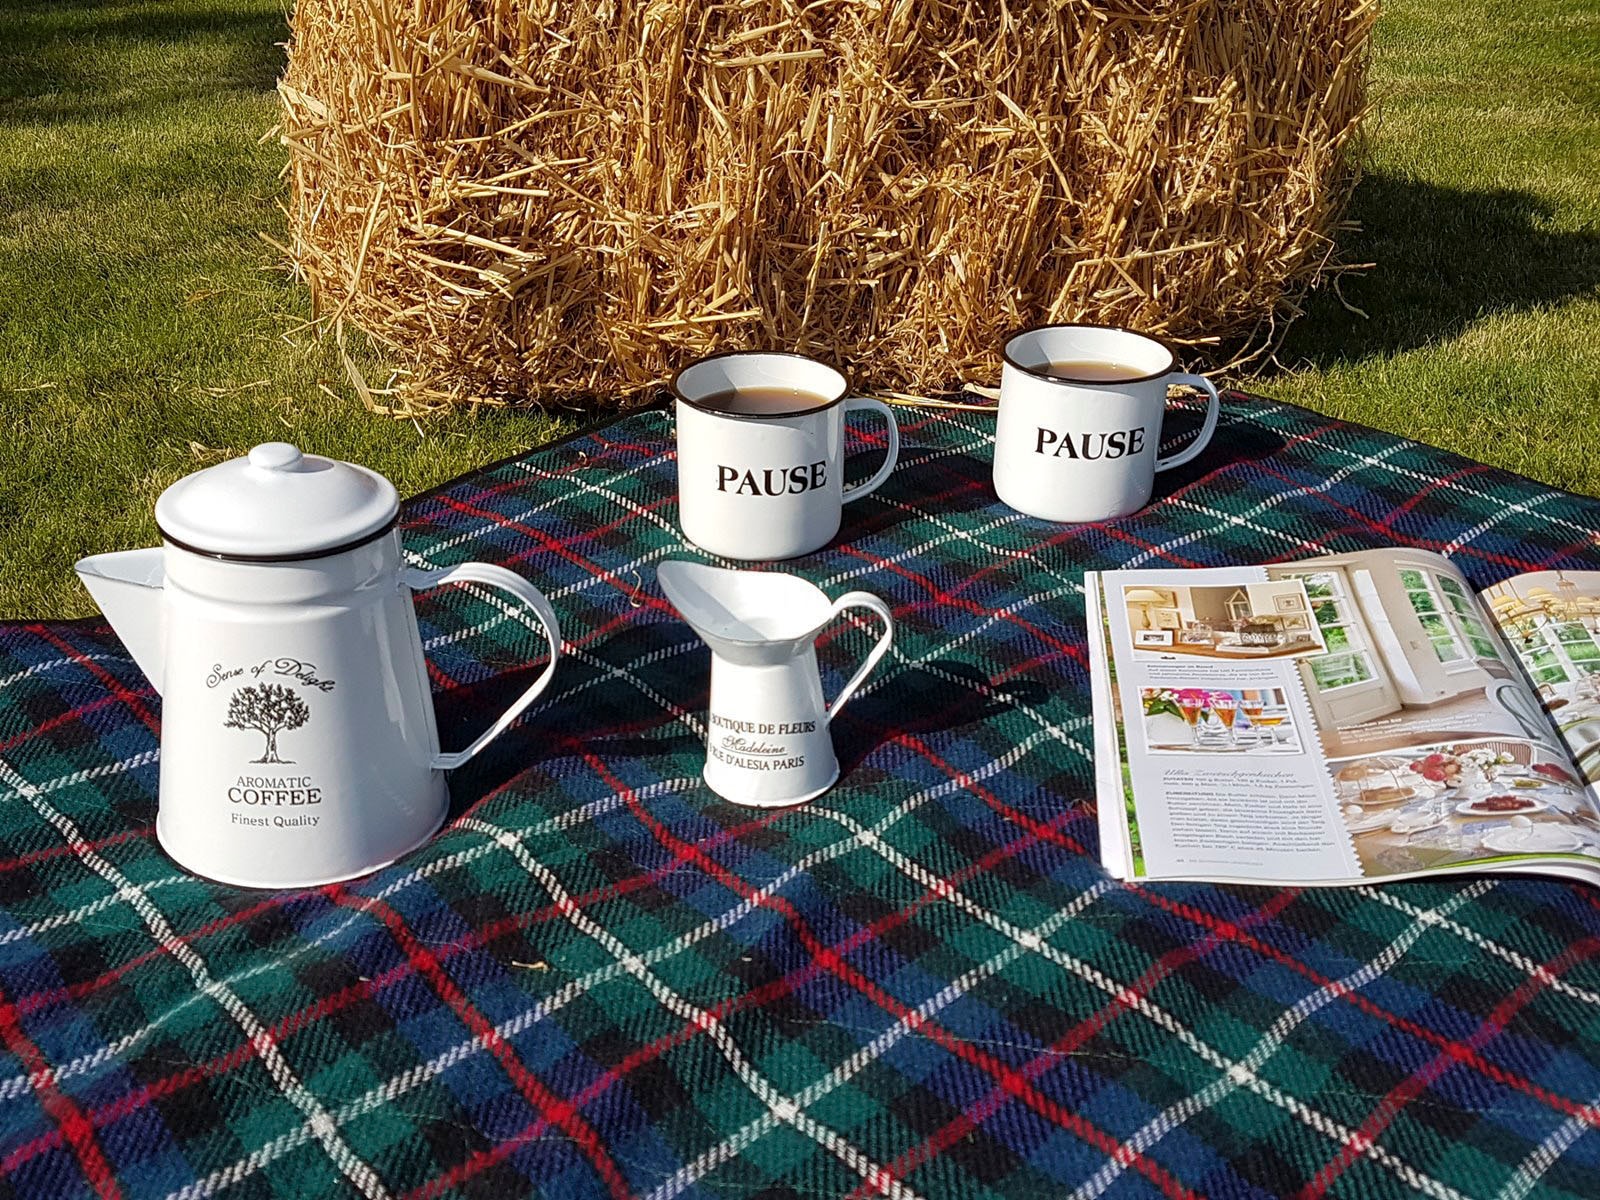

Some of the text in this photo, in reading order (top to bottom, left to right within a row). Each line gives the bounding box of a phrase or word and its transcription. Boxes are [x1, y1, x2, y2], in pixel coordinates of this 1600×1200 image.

[1035, 427, 1146, 461] PAUSE
[717, 460, 828, 497] PAUSE
[206, 657, 336, 693] Sense of Delight
[758, 723, 774, 735] DE
[778, 720, 817, 735] FLEURS
[773, 755, 805, 771] PARIS
[236, 776, 312, 788] AROMATIC
[228, 787, 322, 806] COFFEE
[231, 813, 320, 828] Finest Quality
